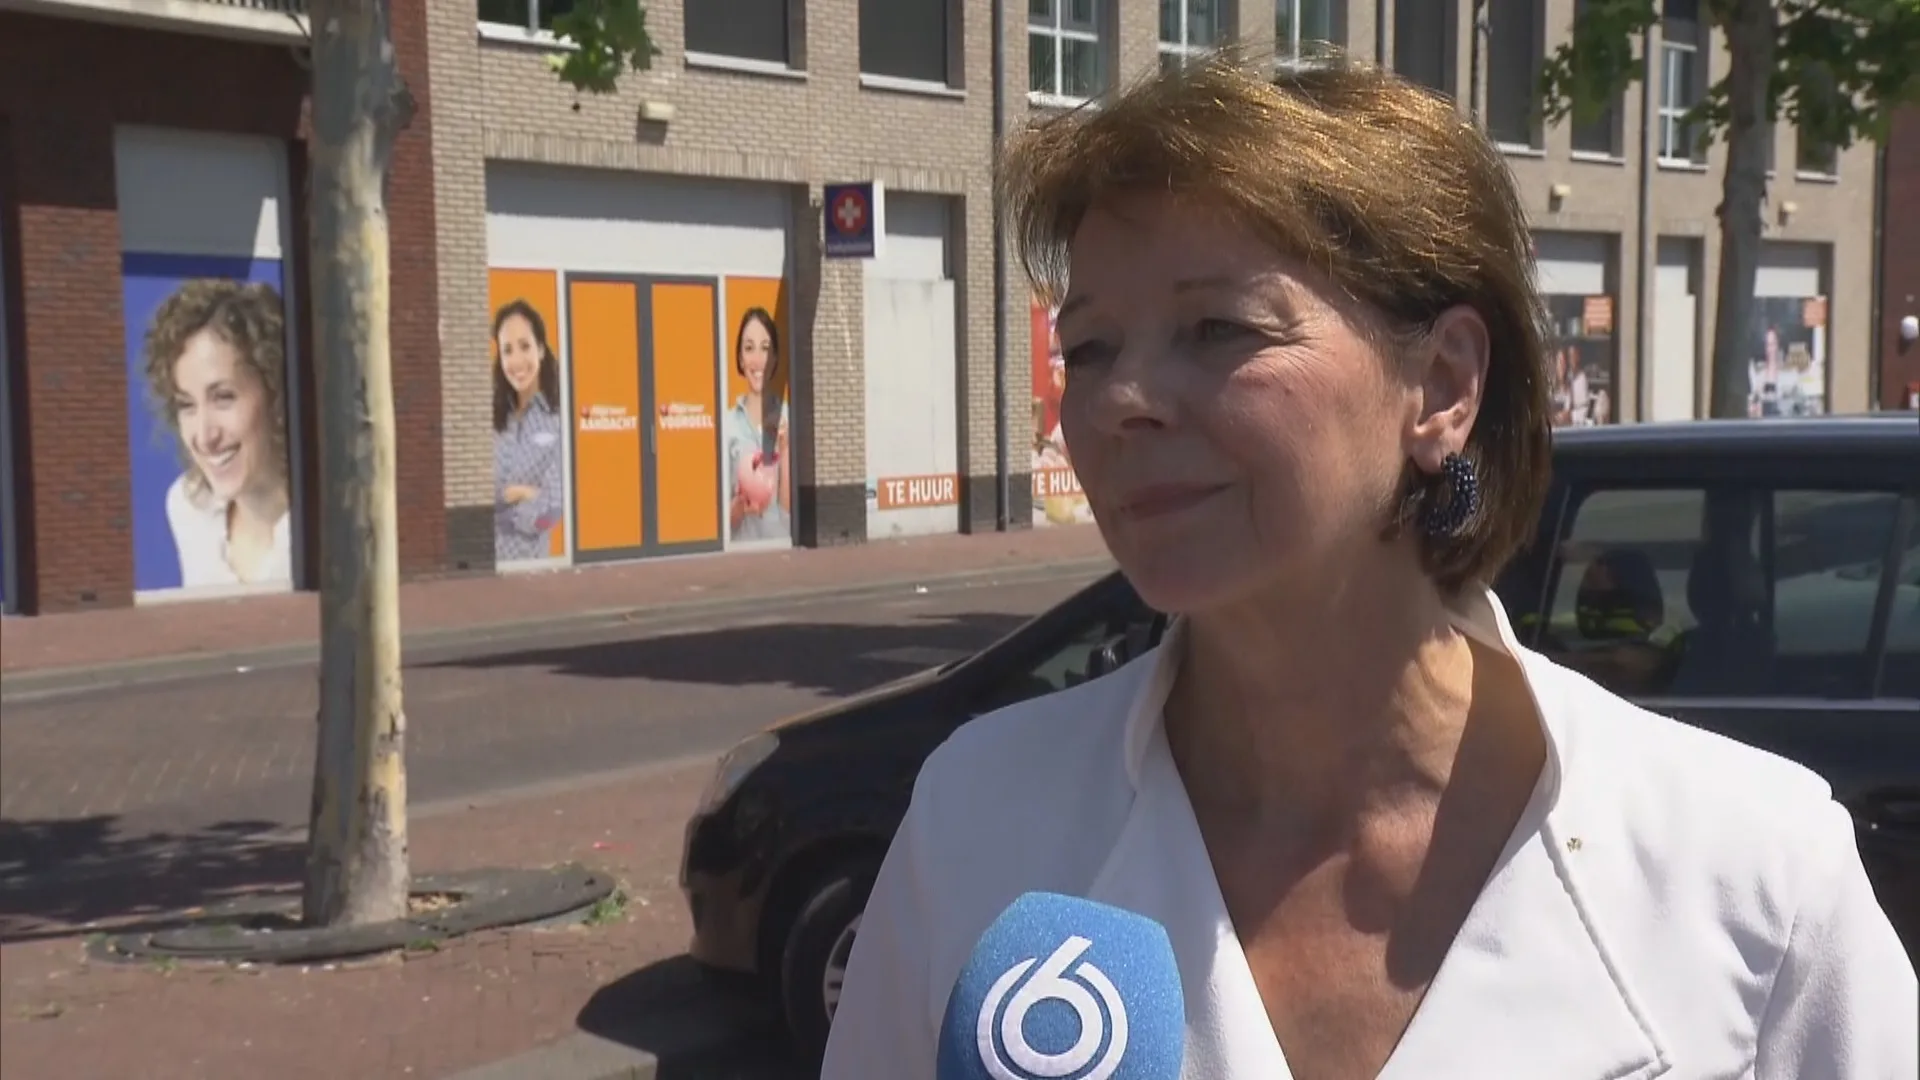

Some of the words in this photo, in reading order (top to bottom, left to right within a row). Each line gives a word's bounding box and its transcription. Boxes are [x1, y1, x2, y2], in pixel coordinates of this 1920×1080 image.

[886, 480, 905, 506] TE
[909, 477, 954, 504] HUUR
[1050, 470, 1082, 493] HUU
[1002, 935, 1104, 1078] 6
